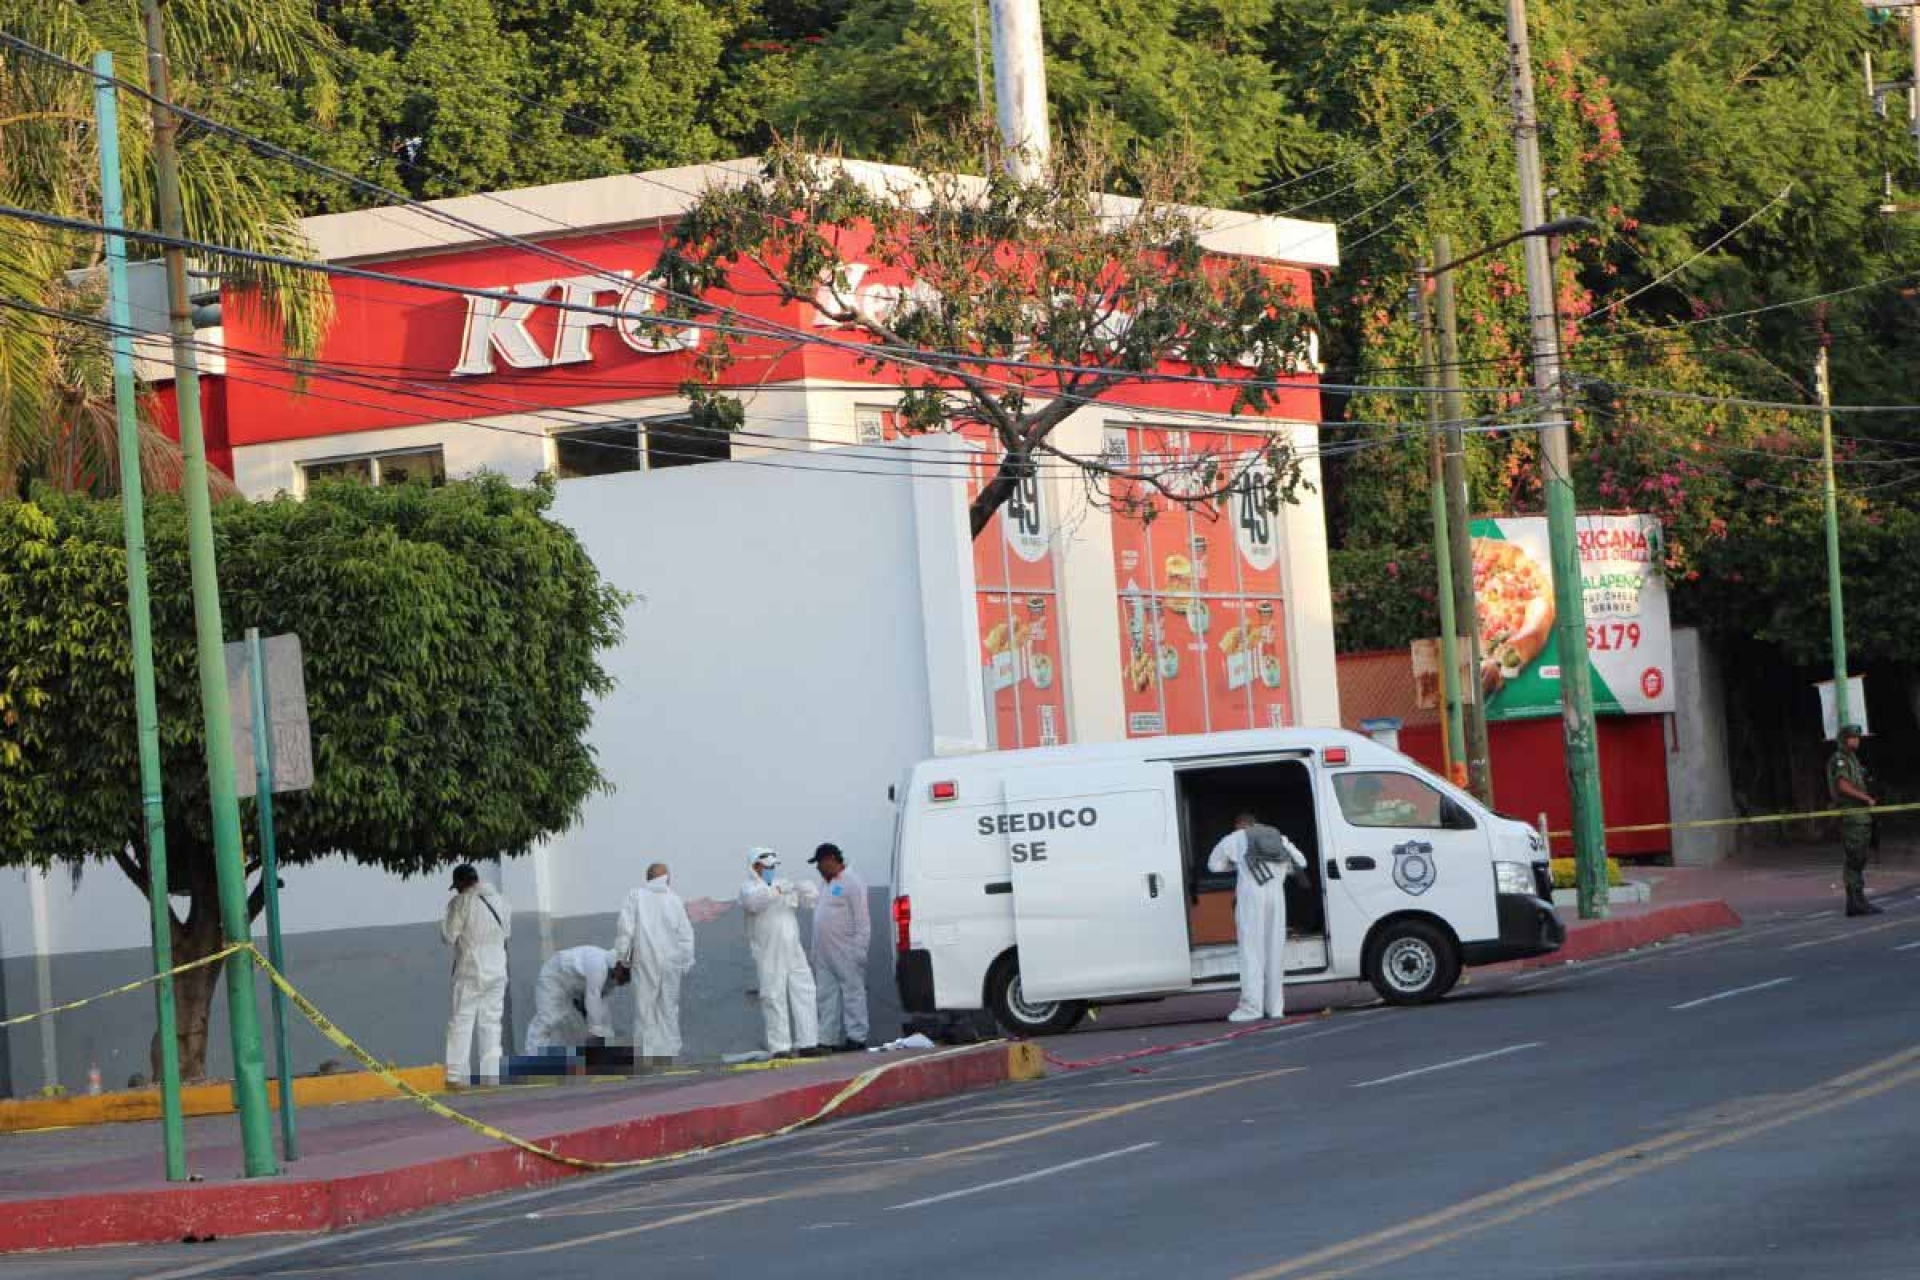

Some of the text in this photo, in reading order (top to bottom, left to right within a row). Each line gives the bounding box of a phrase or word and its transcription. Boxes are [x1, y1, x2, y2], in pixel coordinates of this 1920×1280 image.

[450, 268, 700, 377] KFC
[1576, 530, 1648, 550] XICANA
[1586, 622, 1640, 650] $179
[1011, 841, 1048, 863] SE
